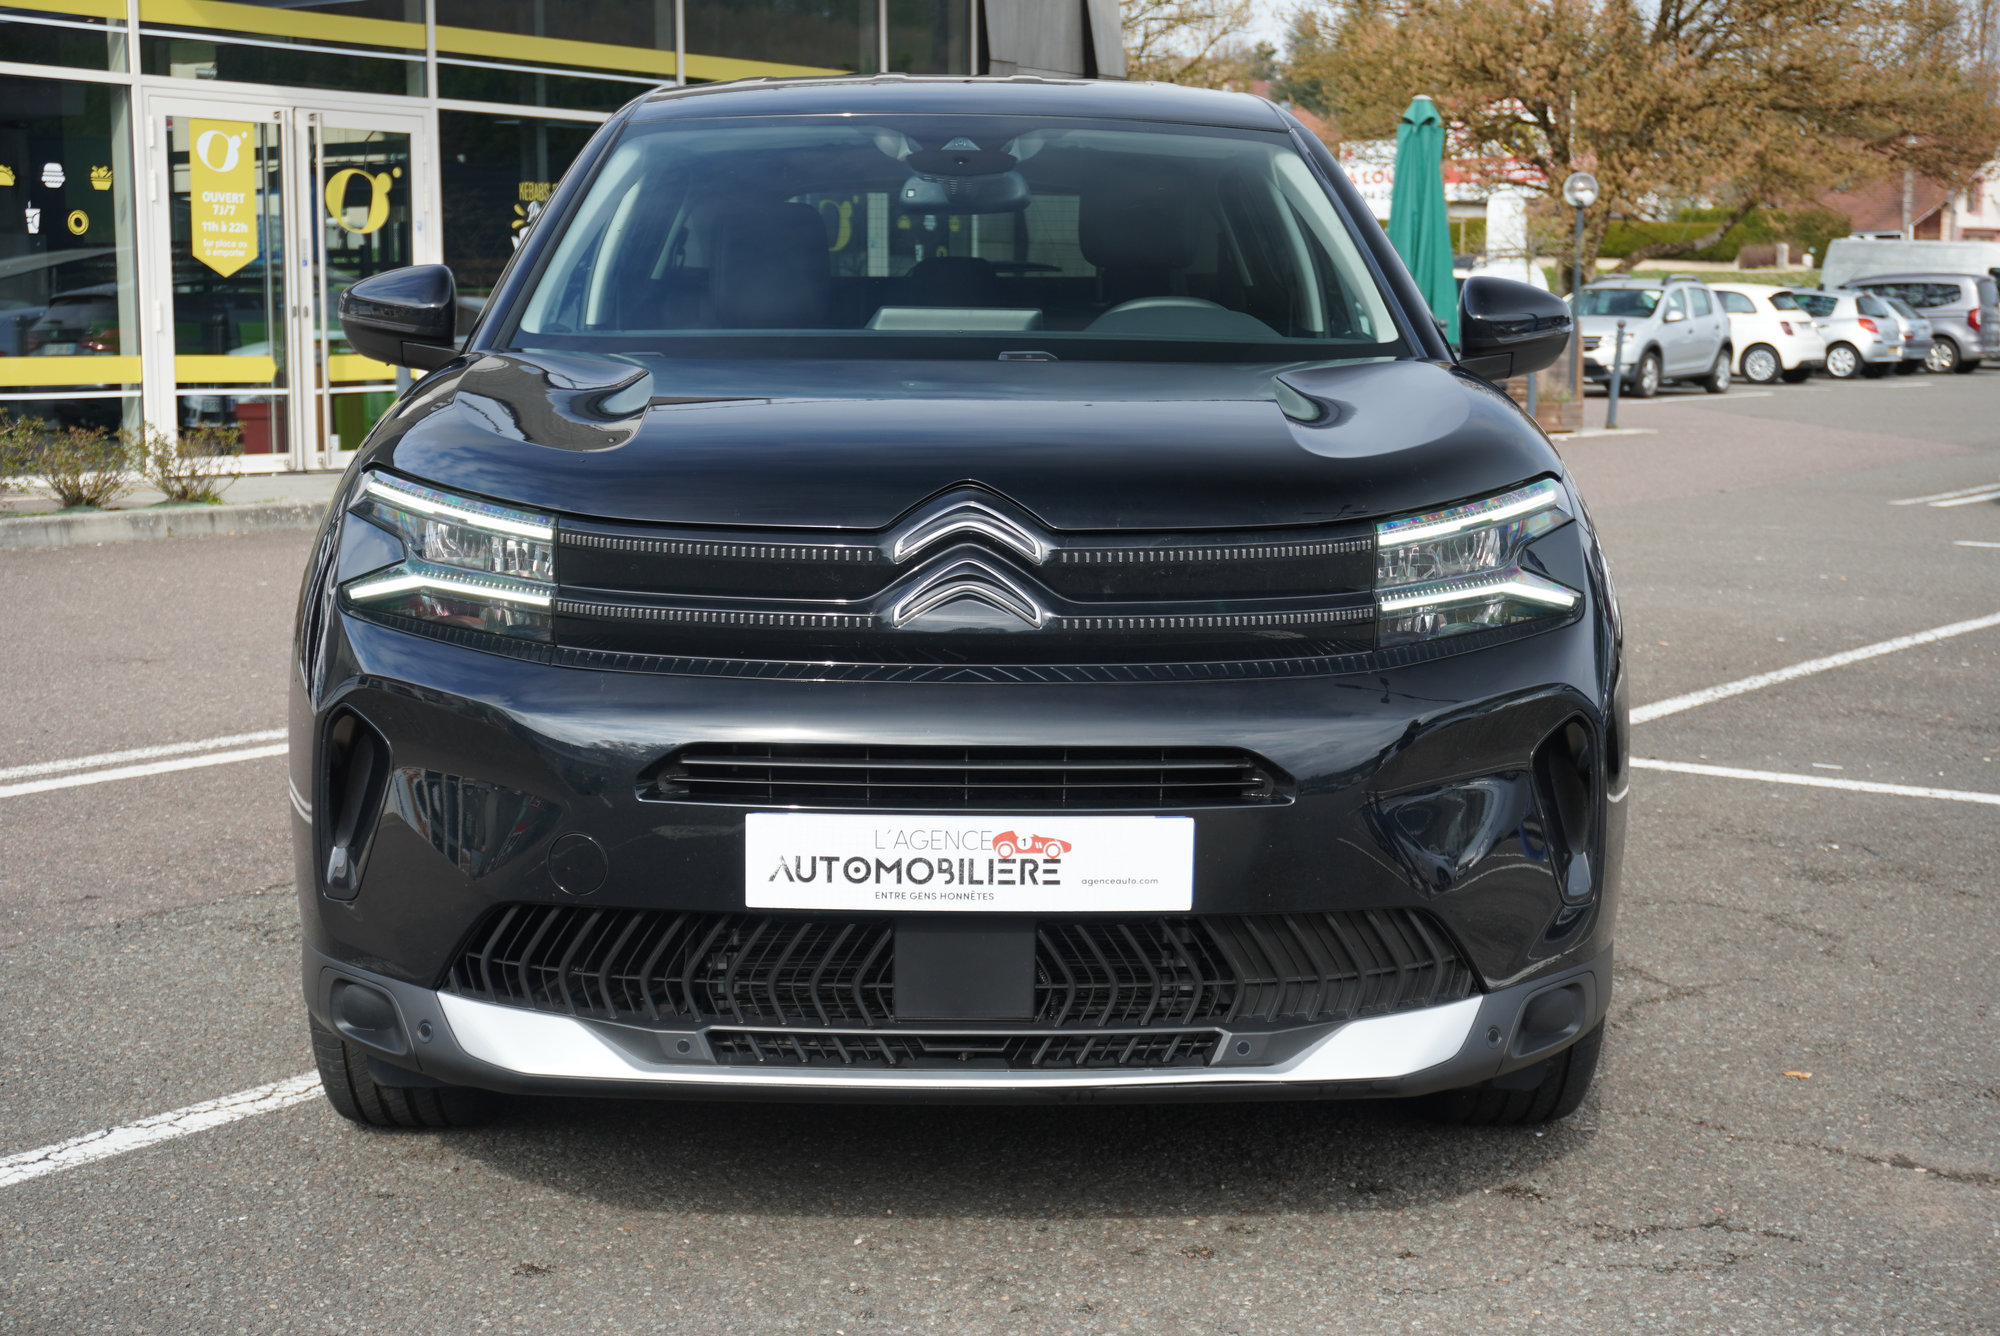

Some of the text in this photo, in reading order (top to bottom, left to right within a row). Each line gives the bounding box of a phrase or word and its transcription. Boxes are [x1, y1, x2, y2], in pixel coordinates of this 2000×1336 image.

[202, 191, 245, 203] OUVERT
[201, 221, 219, 232] 11h
[229, 222, 248, 233] 22h
[874, 828, 993, 850] L'AGENCE
[1081, 878, 1159, 887] agenceauto.com
[874, 890, 995, 901] ENTRE GENS HONNÊTES
